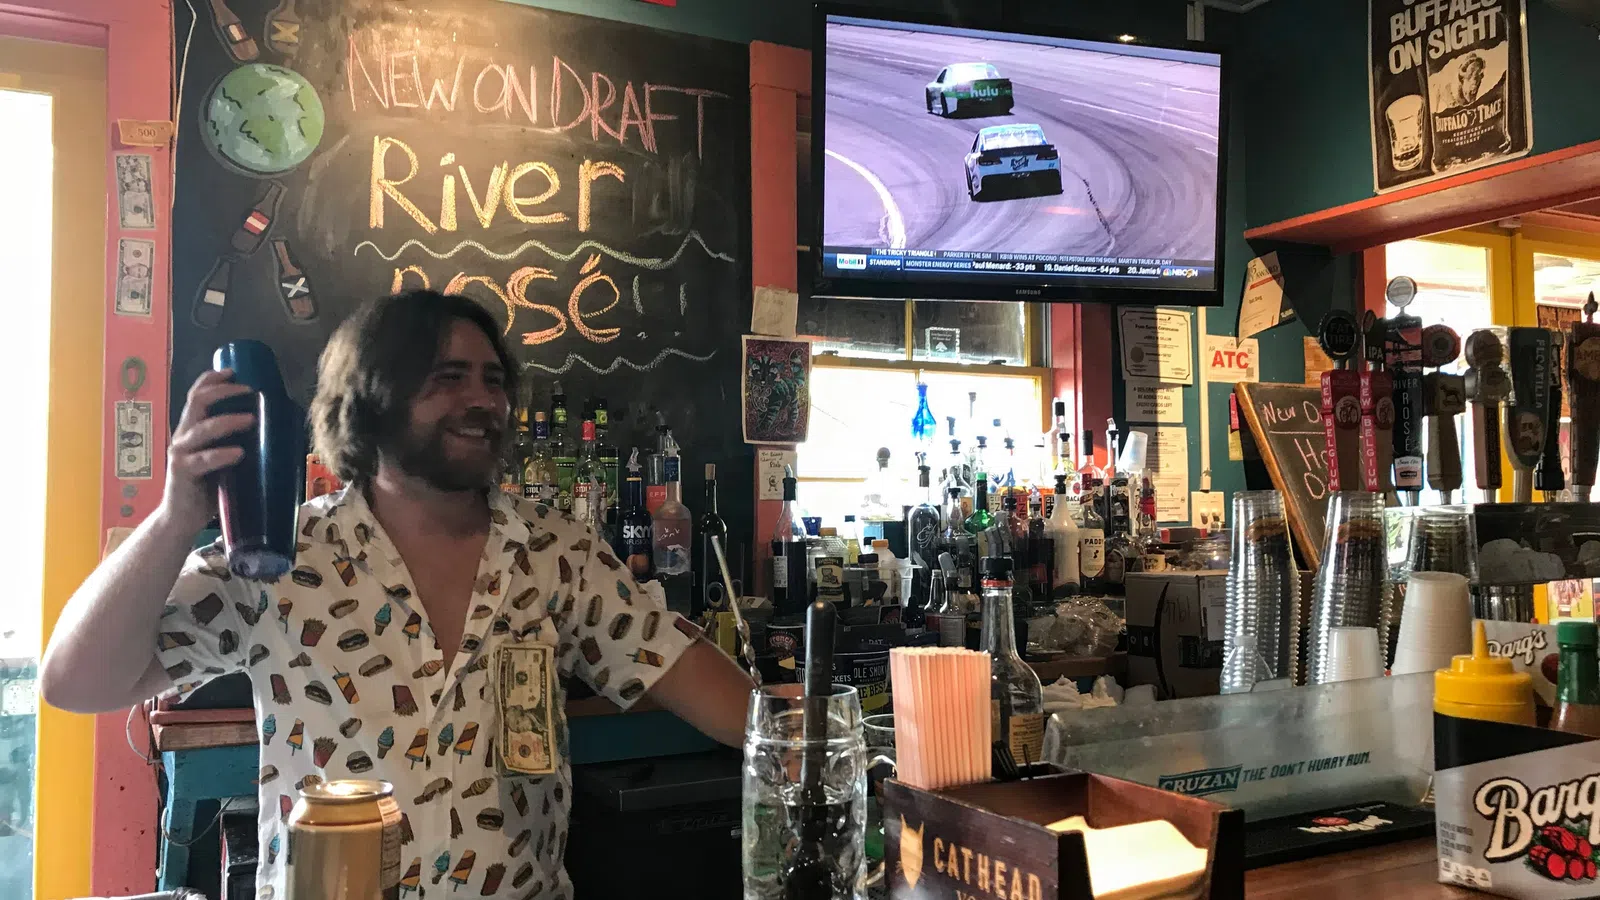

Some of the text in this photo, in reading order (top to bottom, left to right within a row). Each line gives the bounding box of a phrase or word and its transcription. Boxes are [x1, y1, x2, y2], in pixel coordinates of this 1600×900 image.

[1390, 0, 1496, 43] BUFFAL
[1389, 6, 1502, 75] ON SIGHT
[345, 34, 731, 161] NEW ON DRAFT
[970, 86, 999, 98] hulu
[1435, 98, 1502, 132] BUFFALO TRACE
[136, 128, 156, 138] 500
[368, 135, 626, 234] River
[906, 260, 932, 268] MONSTER
[953, 261, 971, 269] SERIES
[1012, 263, 1024, 271] -33
[1024, 264, 1036, 272] pts
[1054, 264, 1074, 272] Daniel
[1109, 266, 1120, 274] pts
[1138, 267, 1156, 275] Jamie
[1035, 254, 1058, 262] POCONO
[1212, 350, 1249, 369] ATC
[1368, 346, 1383, 360] IPA
[1393, 378, 1418, 389] RIVER
[1263, 402, 1296, 427] New
[1321, 377, 1339, 487] NEW BELGIUM
[1361, 377, 1378, 487] NEW BELGIUM
[832, 674, 852, 682] CKETS
[853, 666, 867, 678] OLE
[1242, 750, 1372, 783] THE DON'T HURRY RUM.
[1161, 770, 1238, 793] CRUZAN
[933, 837, 1043, 900] CATHEAD
